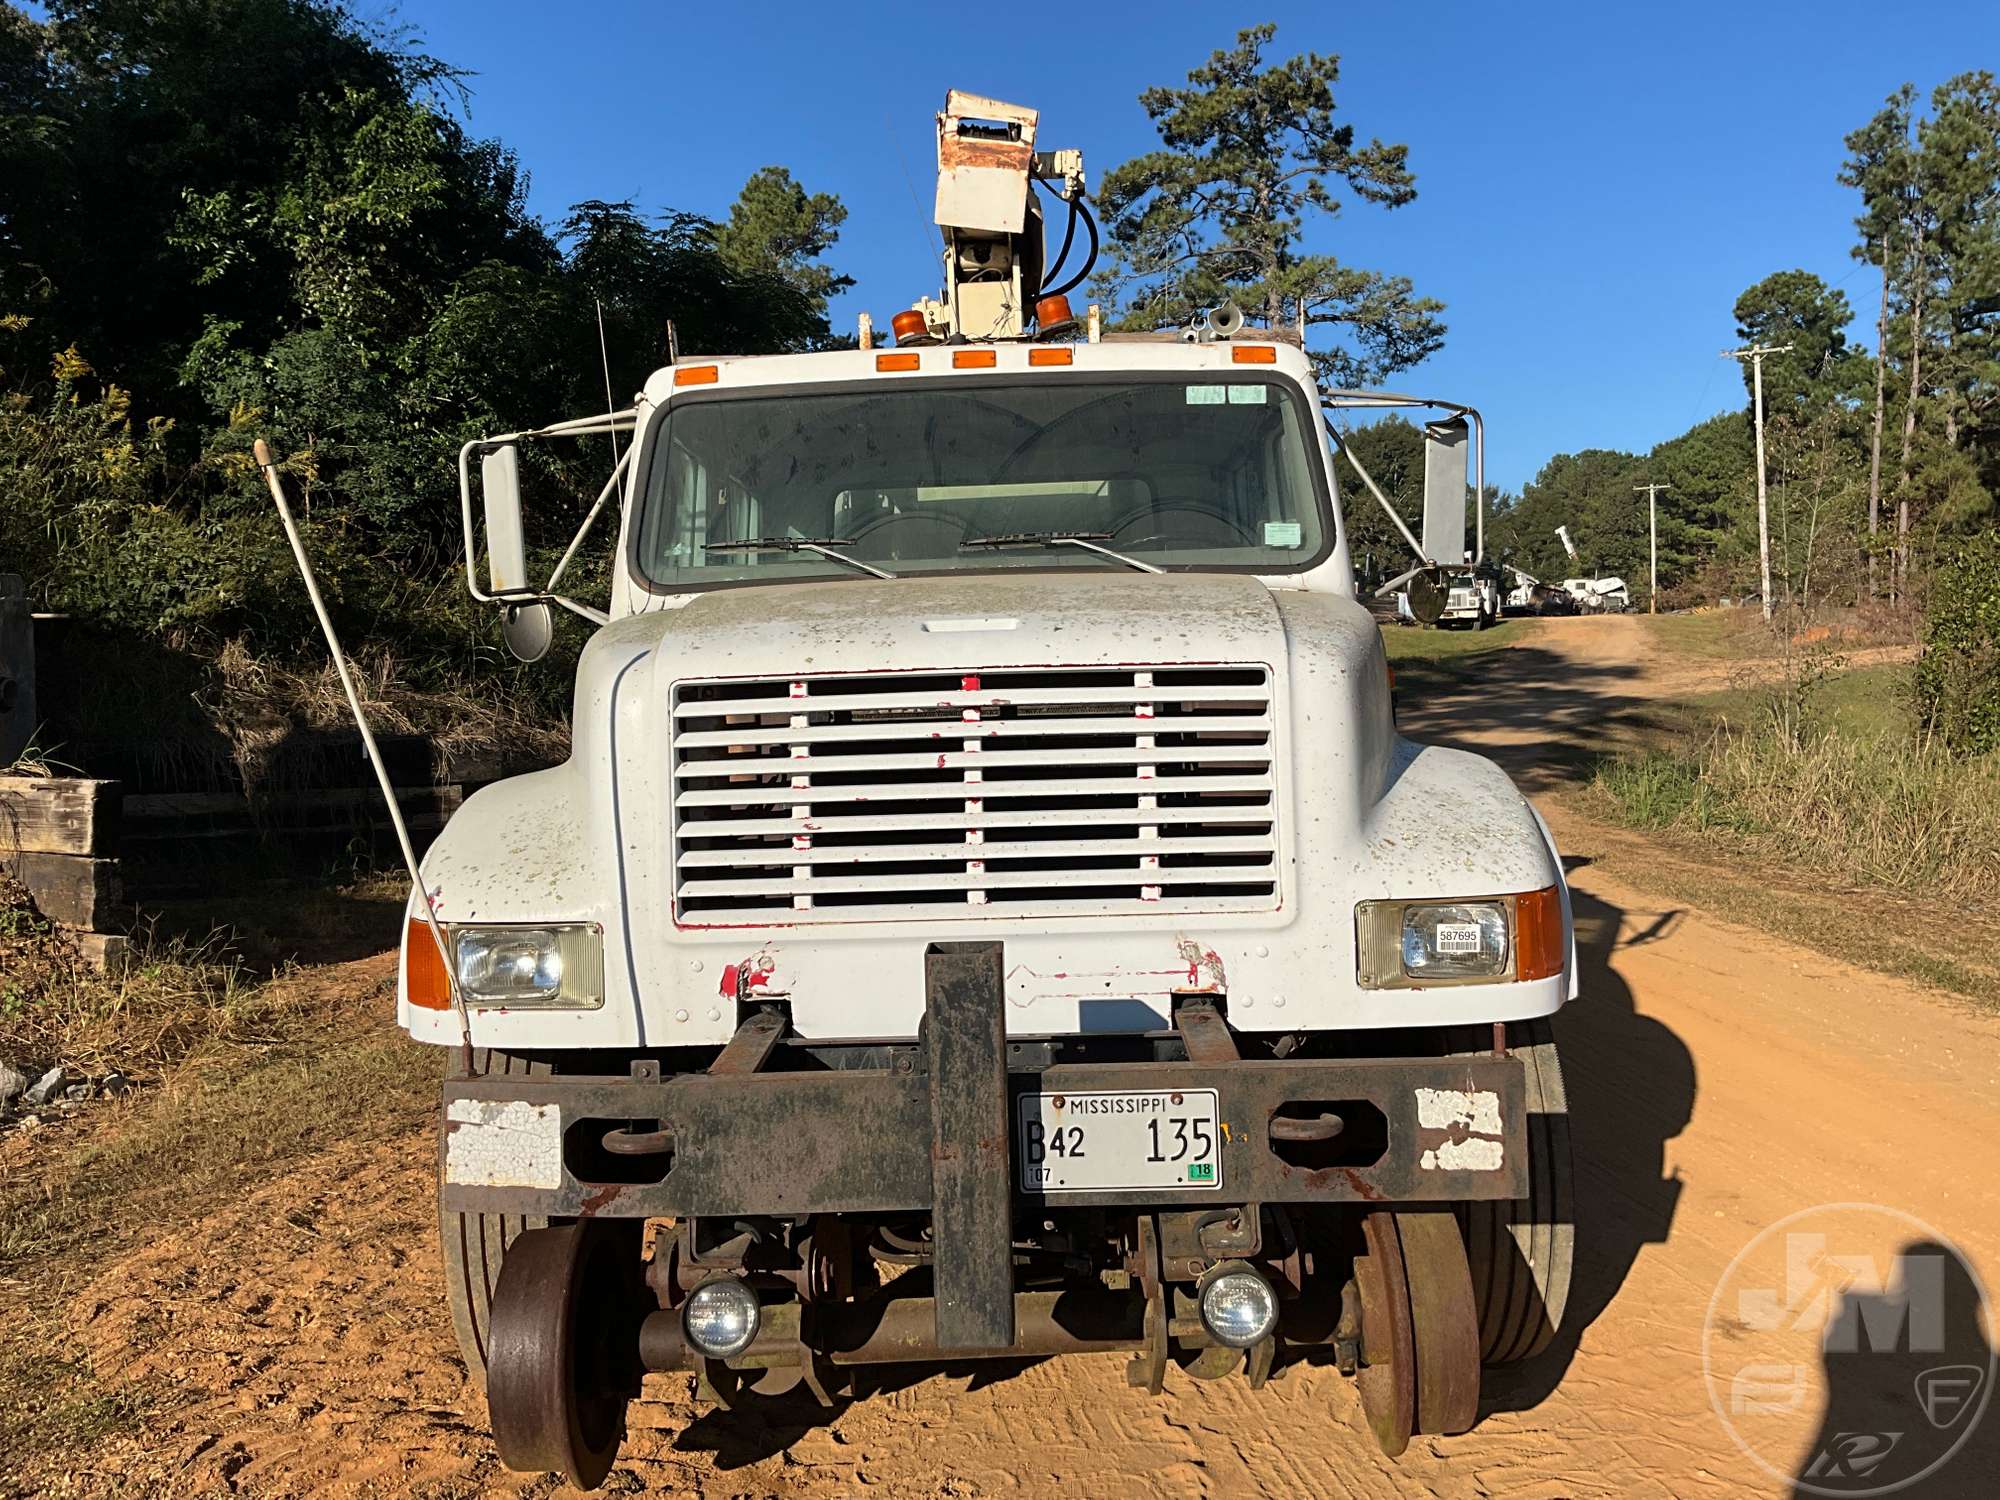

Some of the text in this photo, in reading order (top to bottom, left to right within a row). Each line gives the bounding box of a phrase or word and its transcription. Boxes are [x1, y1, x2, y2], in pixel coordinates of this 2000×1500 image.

[1440, 931, 1477, 941] 587695
[1071, 1098, 1166, 1114] MISSISSIPPI
[1147, 1118, 1212, 1162] 135
[1196, 1163, 1211, 1175] 18
